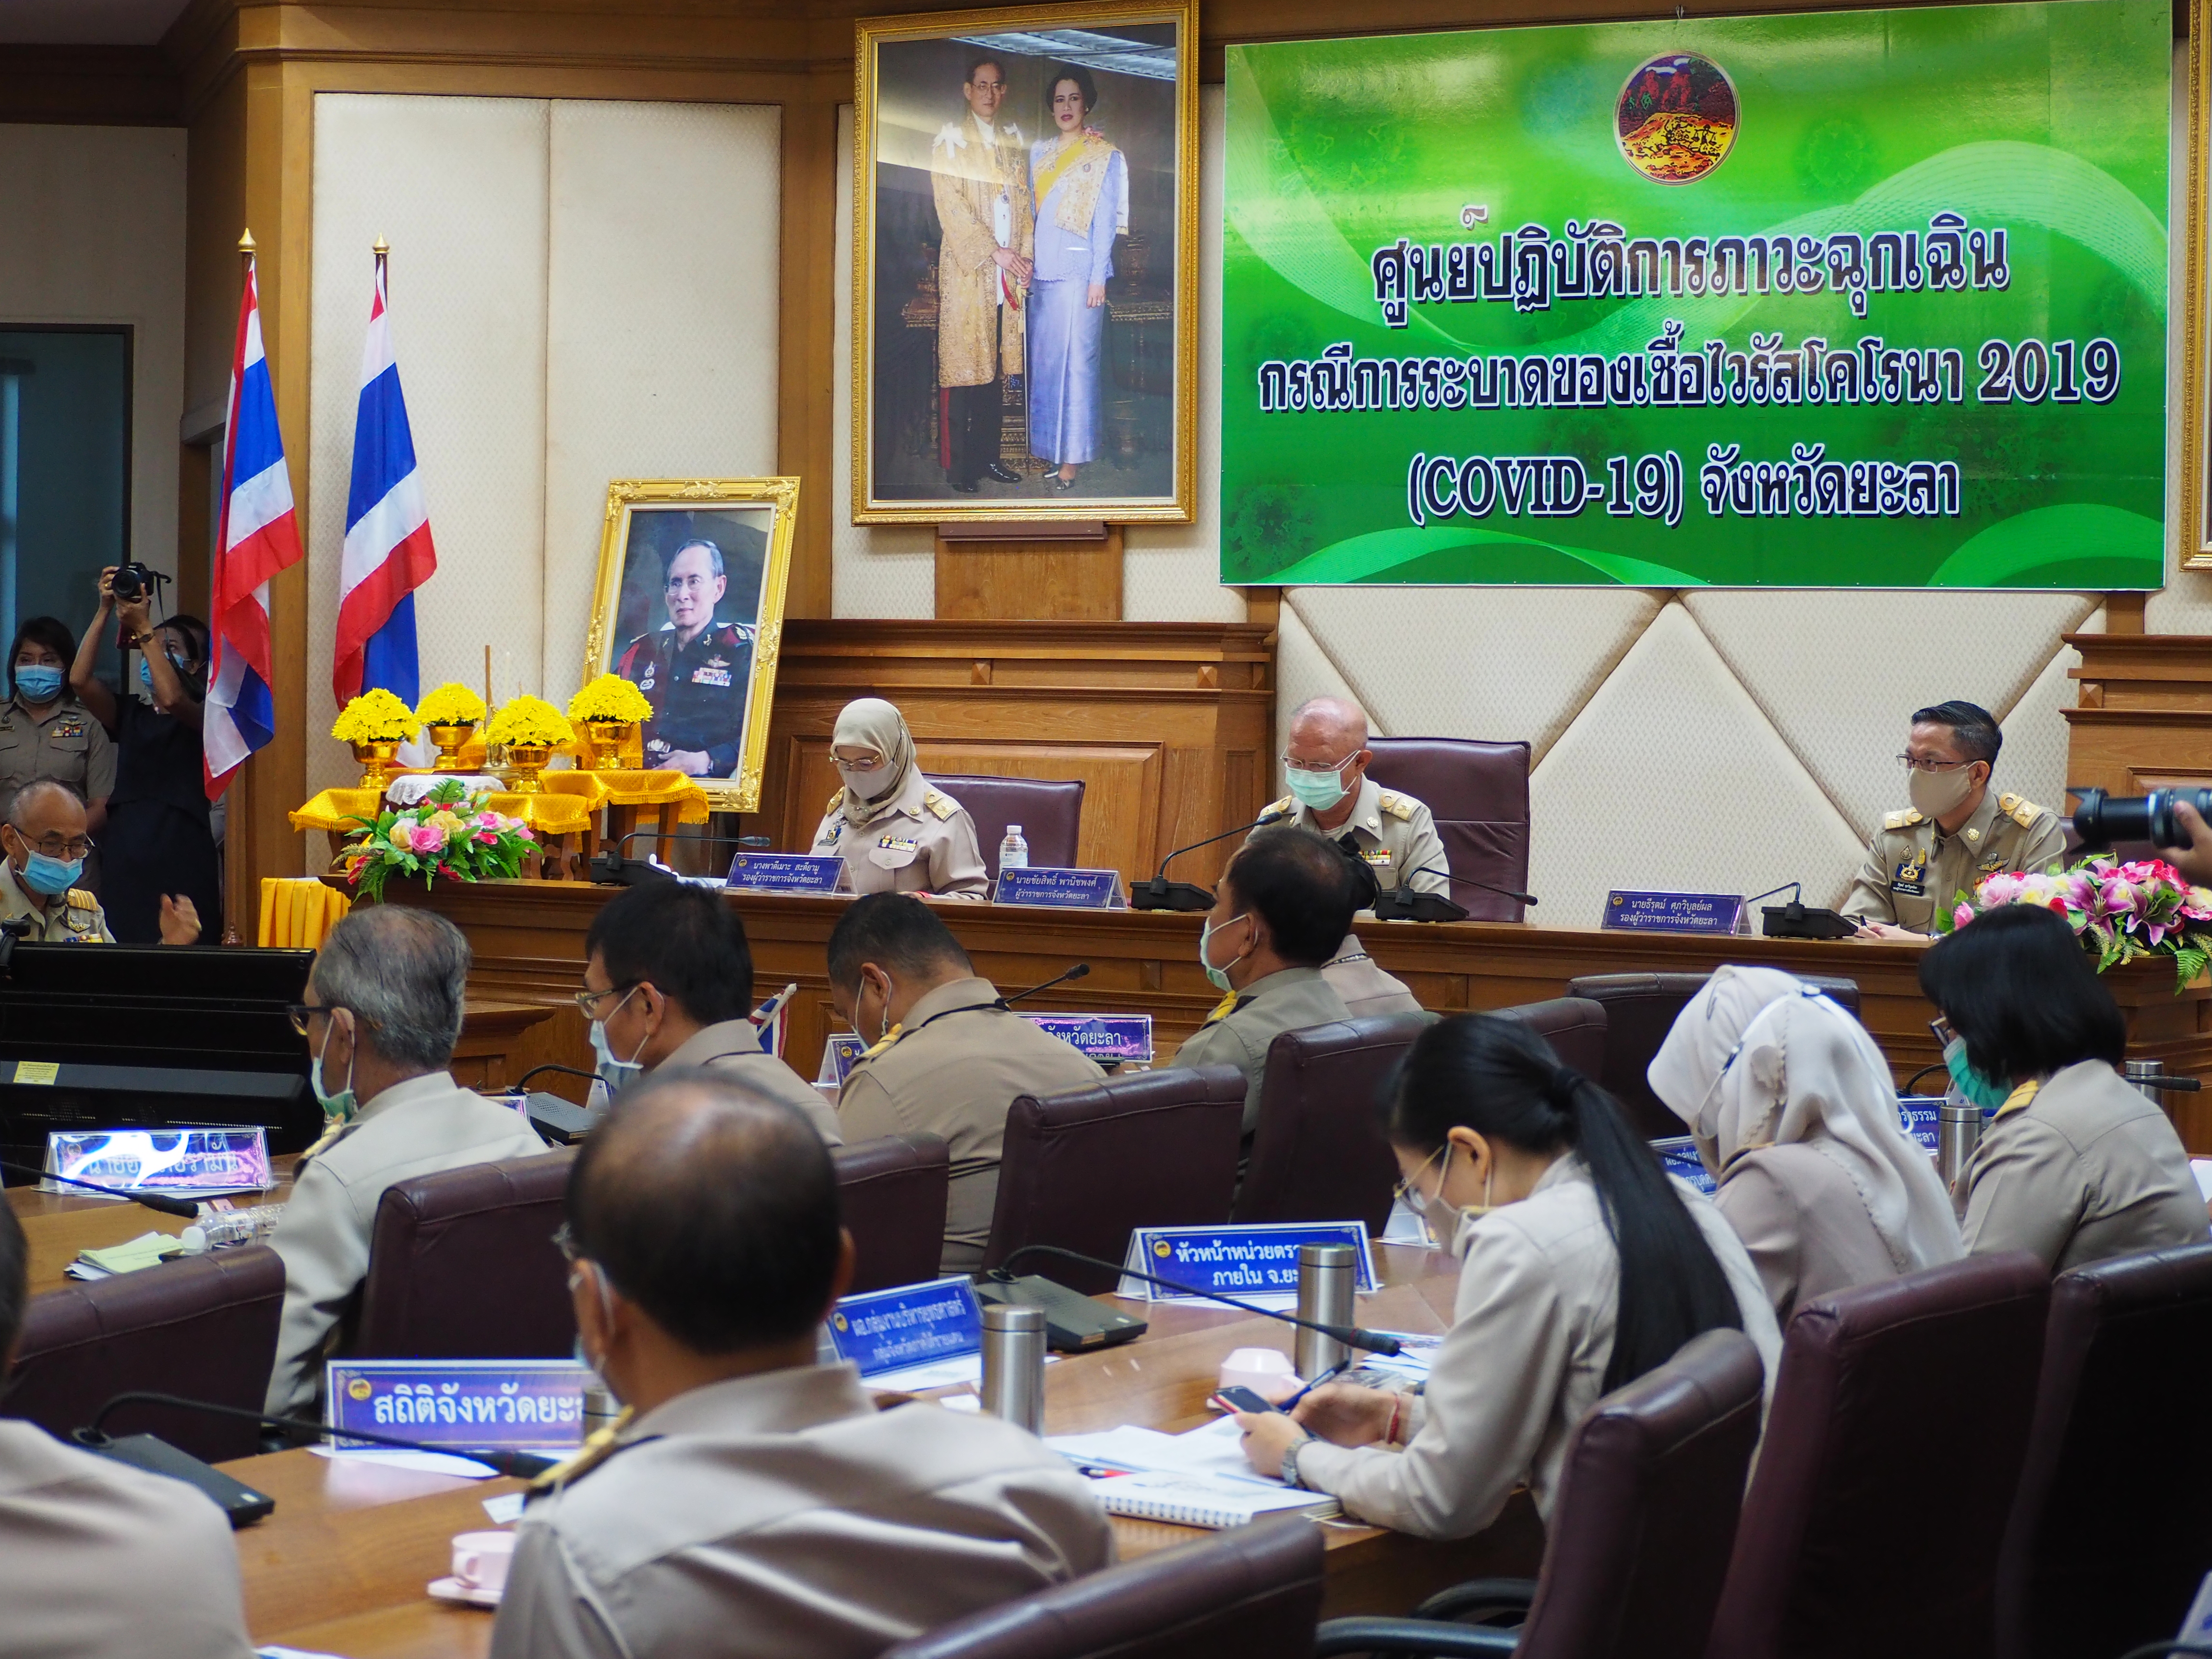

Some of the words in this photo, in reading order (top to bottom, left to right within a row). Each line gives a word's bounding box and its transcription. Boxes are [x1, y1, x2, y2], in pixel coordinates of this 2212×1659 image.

[1371, 205, 2010, 328] ศูนย์ปฏิบัติการภาวะฉุกเฉิน
[1258, 318, 1963, 411] กรณีการระบาดของเชื้อไวรัสโคโรนา
[1978, 337, 2120, 403] 2019
[1408, 451, 1683, 527] (COVID-19)
[1701, 443, 1960, 517] จังหวัดยะลา
[743, 871, 822, 884] รองผู้ว่าราชการจังหวัดยะลา
[1016, 873, 1058, 885] นายชัยสิทธิ์
[1059, 876, 1098, 887] พานิชพงศ์
[1015, 889, 1089, 900] ผู้ว่าราชการจังหวัดยะลา
[1632, 898, 1667, 912] นายธีรุตม์
[1671, 899, 1712, 914] ศุภวิบูลย์ผล
[1620, 911, 1718, 926] รองผู้ว่าราชการจังหวัดยะลา
[1213, 1265, 1262, 1286] ภายใน
